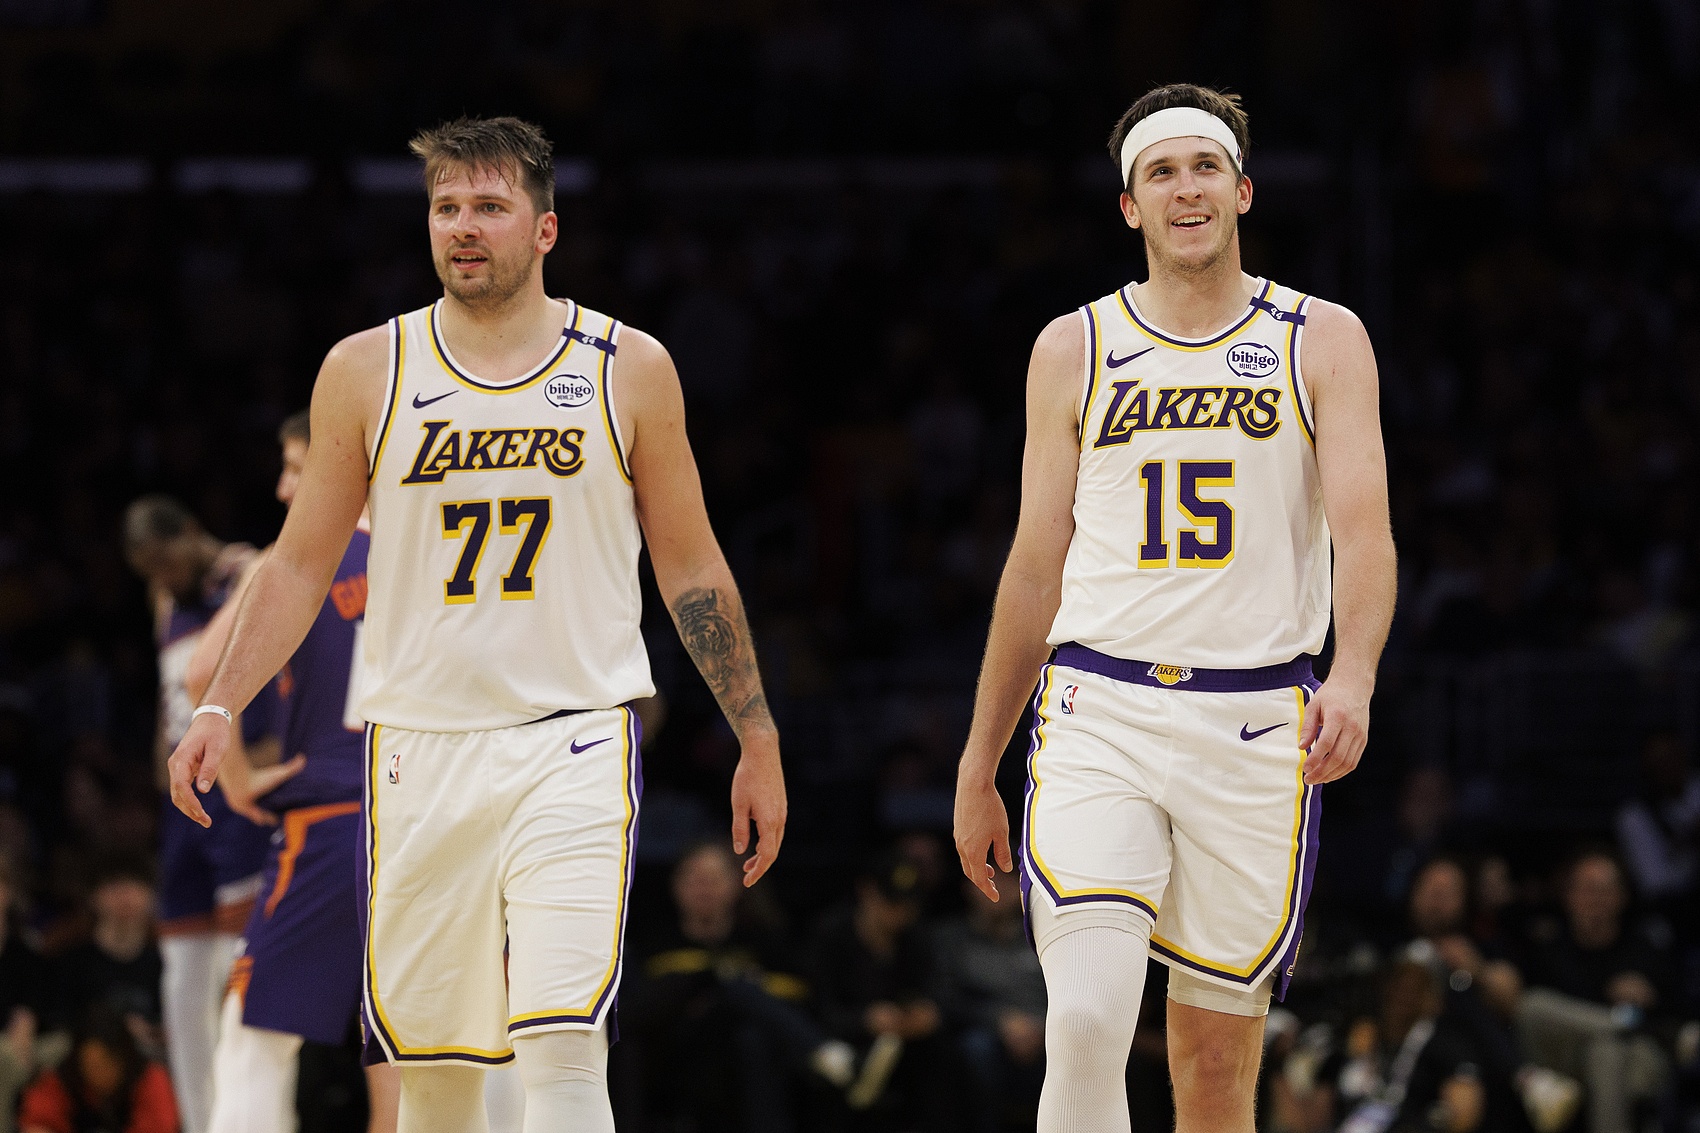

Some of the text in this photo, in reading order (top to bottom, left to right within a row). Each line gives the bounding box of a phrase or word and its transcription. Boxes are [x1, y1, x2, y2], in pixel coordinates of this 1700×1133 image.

[1270, 307, 1284, 320] 44
[1231, 350, 1276, 368] bibigo
[549, 383, 591, 398] bibigo
[1093, 378, 1283, 450] LAKERS
[400, 419, 587, 487] LAKERS
[1137, 459, 1235, 569] 15
[440, 495, 553, 605] 77
[1147, 663, 1193, 682] LAKERS
